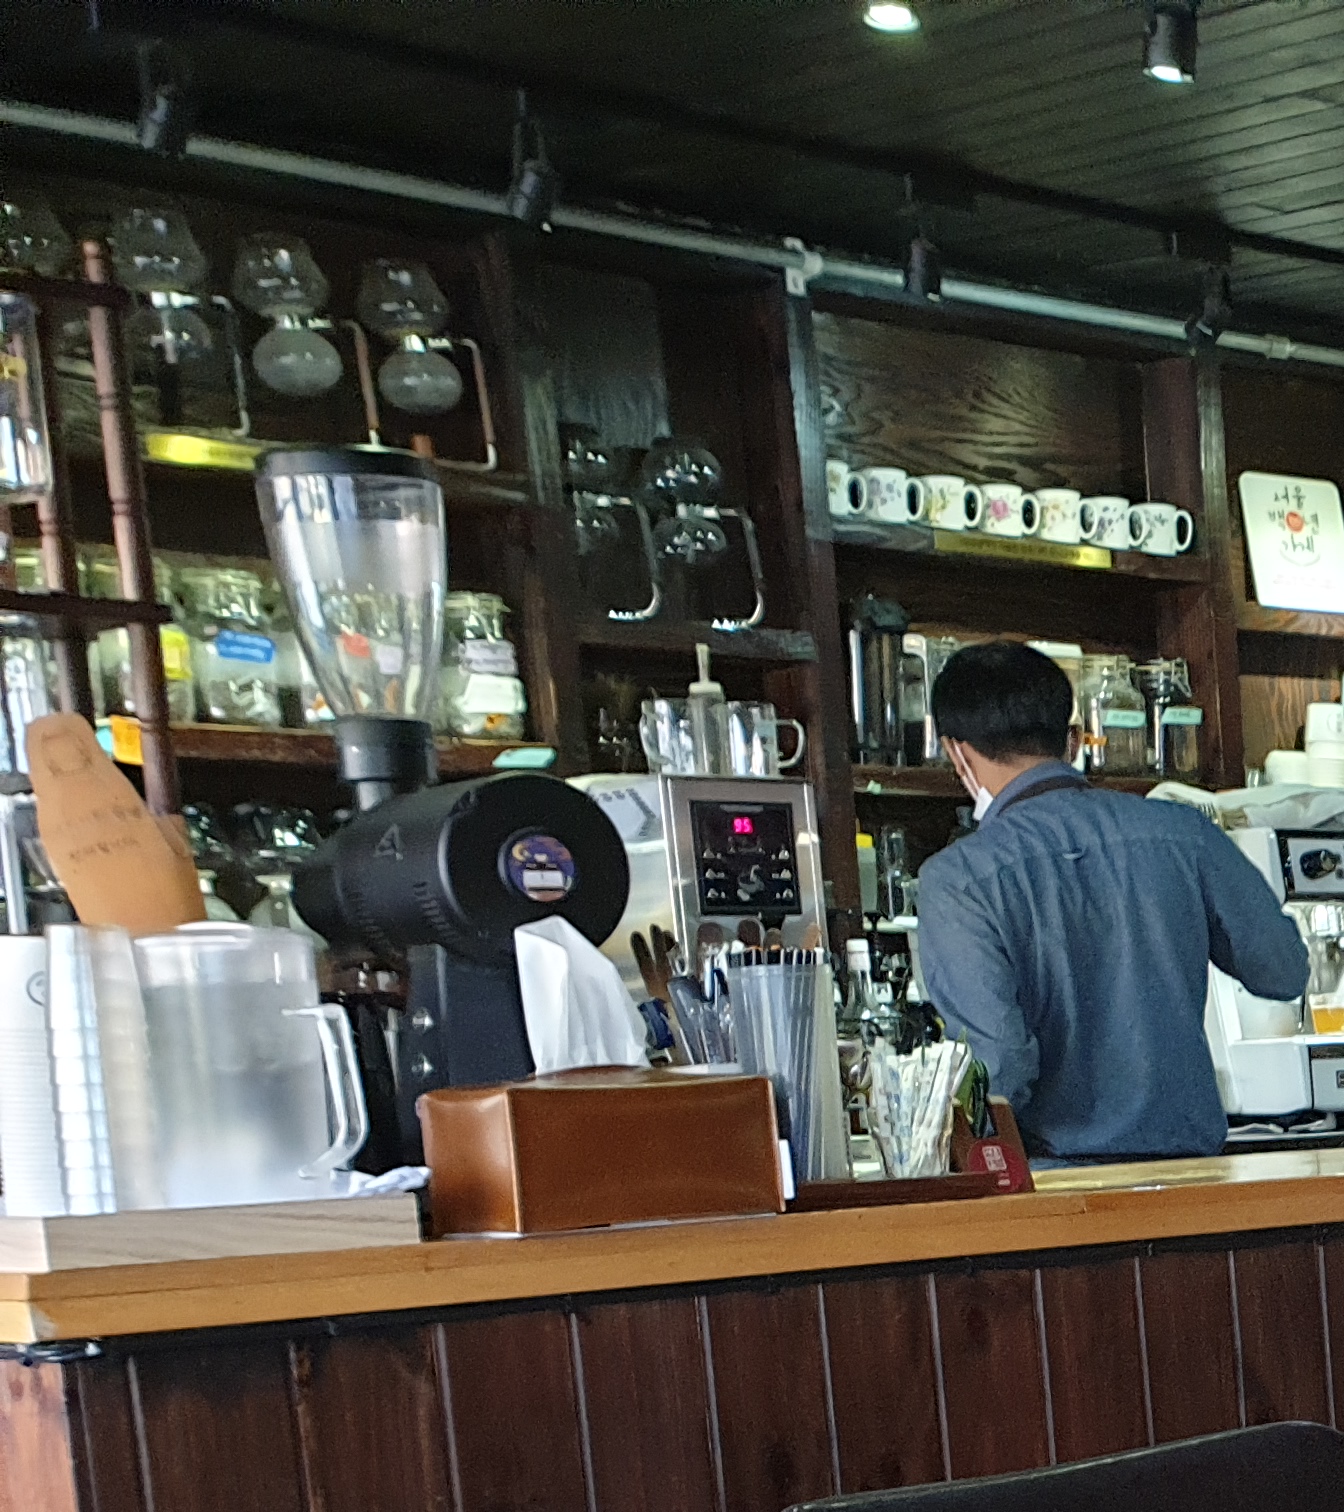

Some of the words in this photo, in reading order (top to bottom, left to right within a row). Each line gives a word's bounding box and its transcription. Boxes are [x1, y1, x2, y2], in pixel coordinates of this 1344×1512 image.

[1274, 485, 1306, 510] 서울
[1282, 533, 1315, 553] 가게
[733, 816, 754, 834] 95
